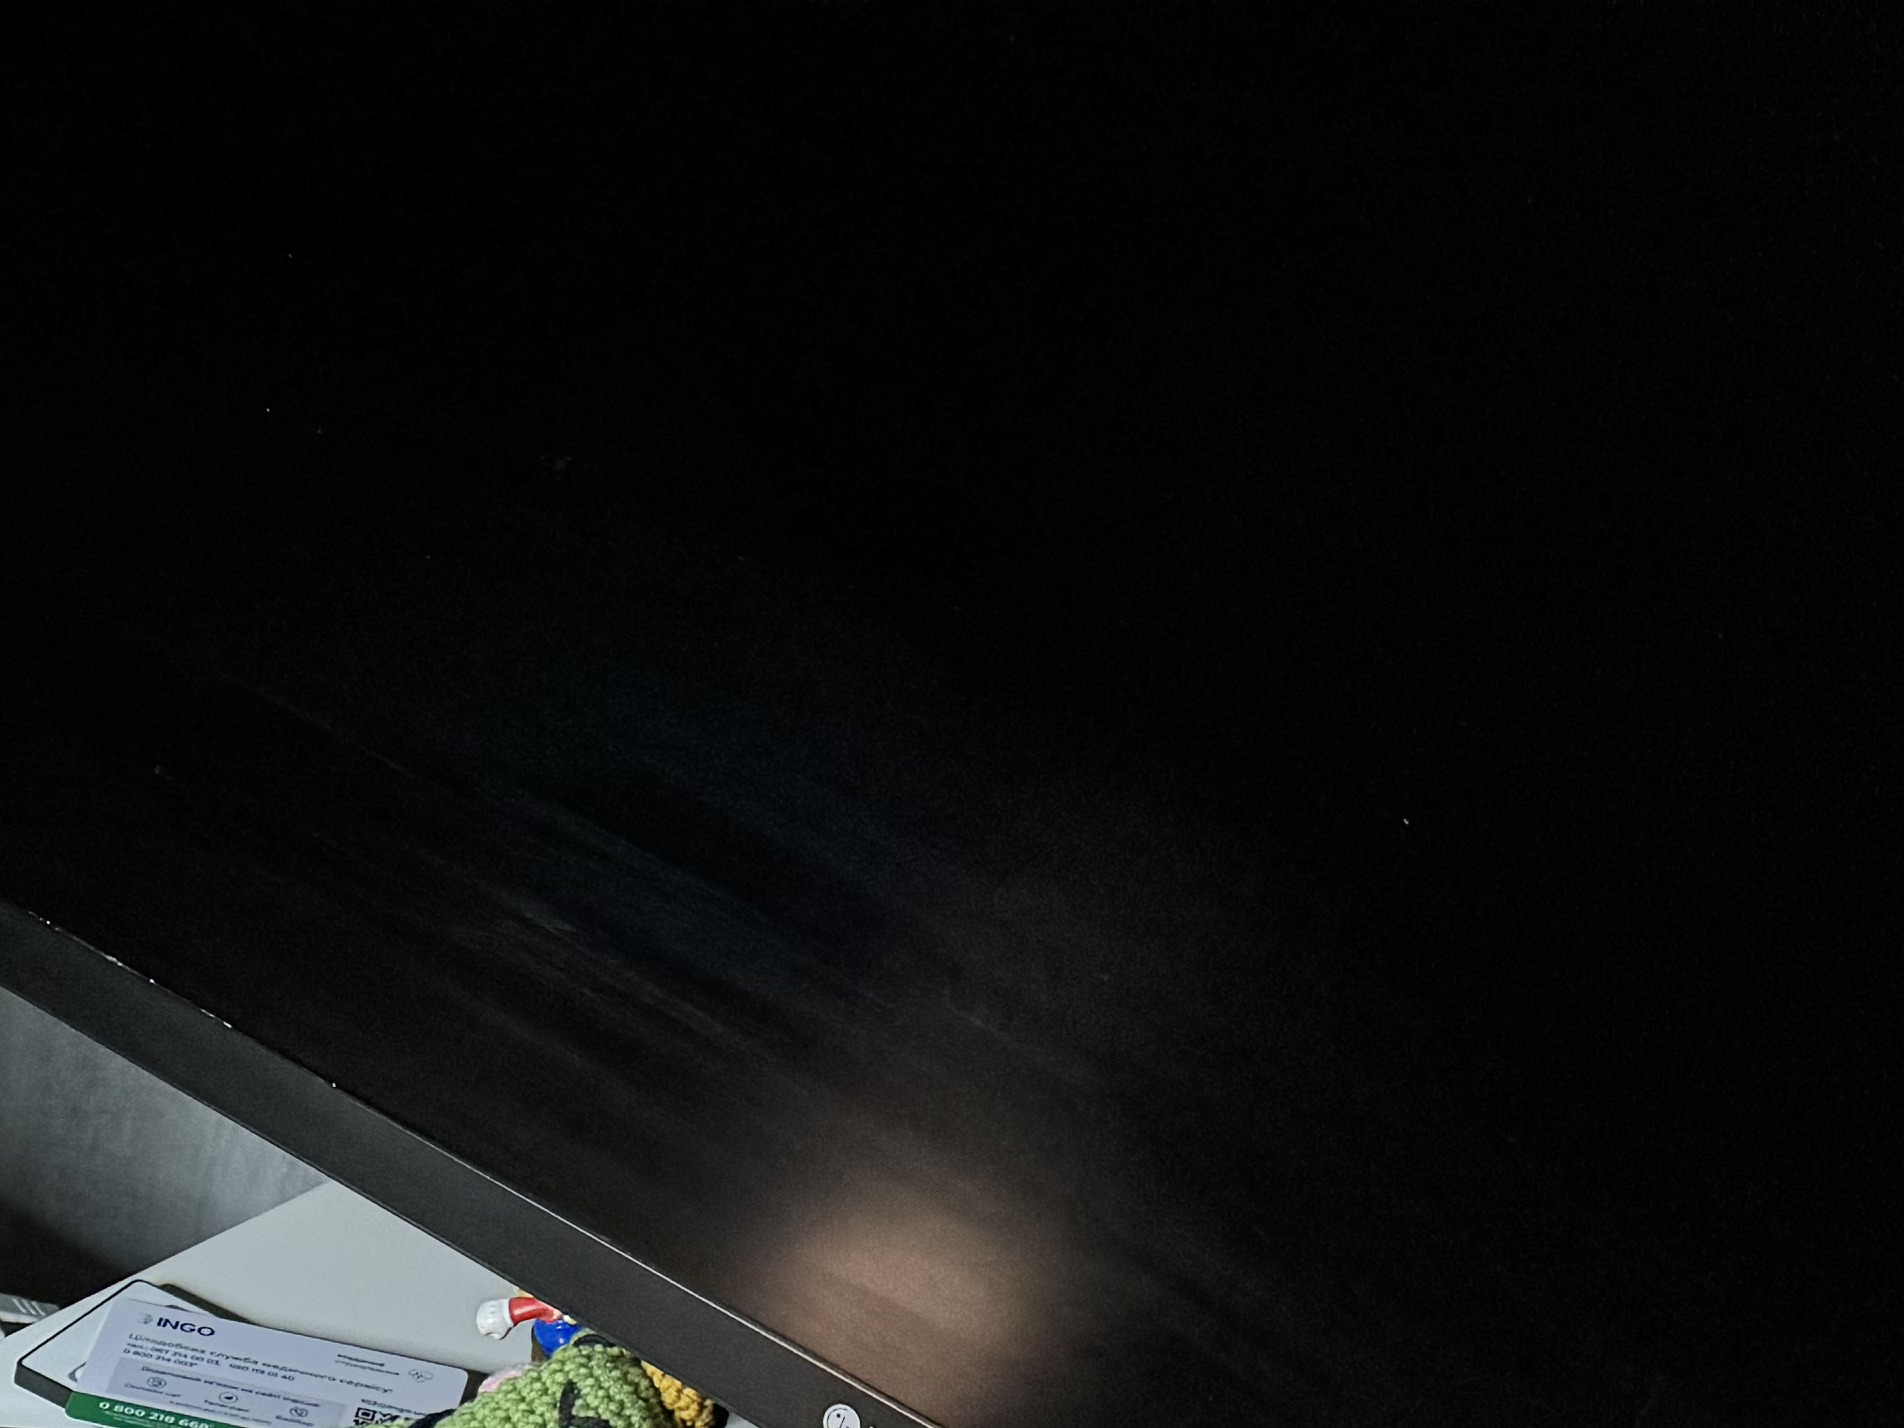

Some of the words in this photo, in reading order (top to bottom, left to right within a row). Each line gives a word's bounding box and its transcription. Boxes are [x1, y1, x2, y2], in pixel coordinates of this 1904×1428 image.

[156, 1316, 216, 1338] INGO
[98, 1401, 110, 1411] 0
[112, 1403, 144, 1418] 800
[147, 1409, 176, 1425] 218
